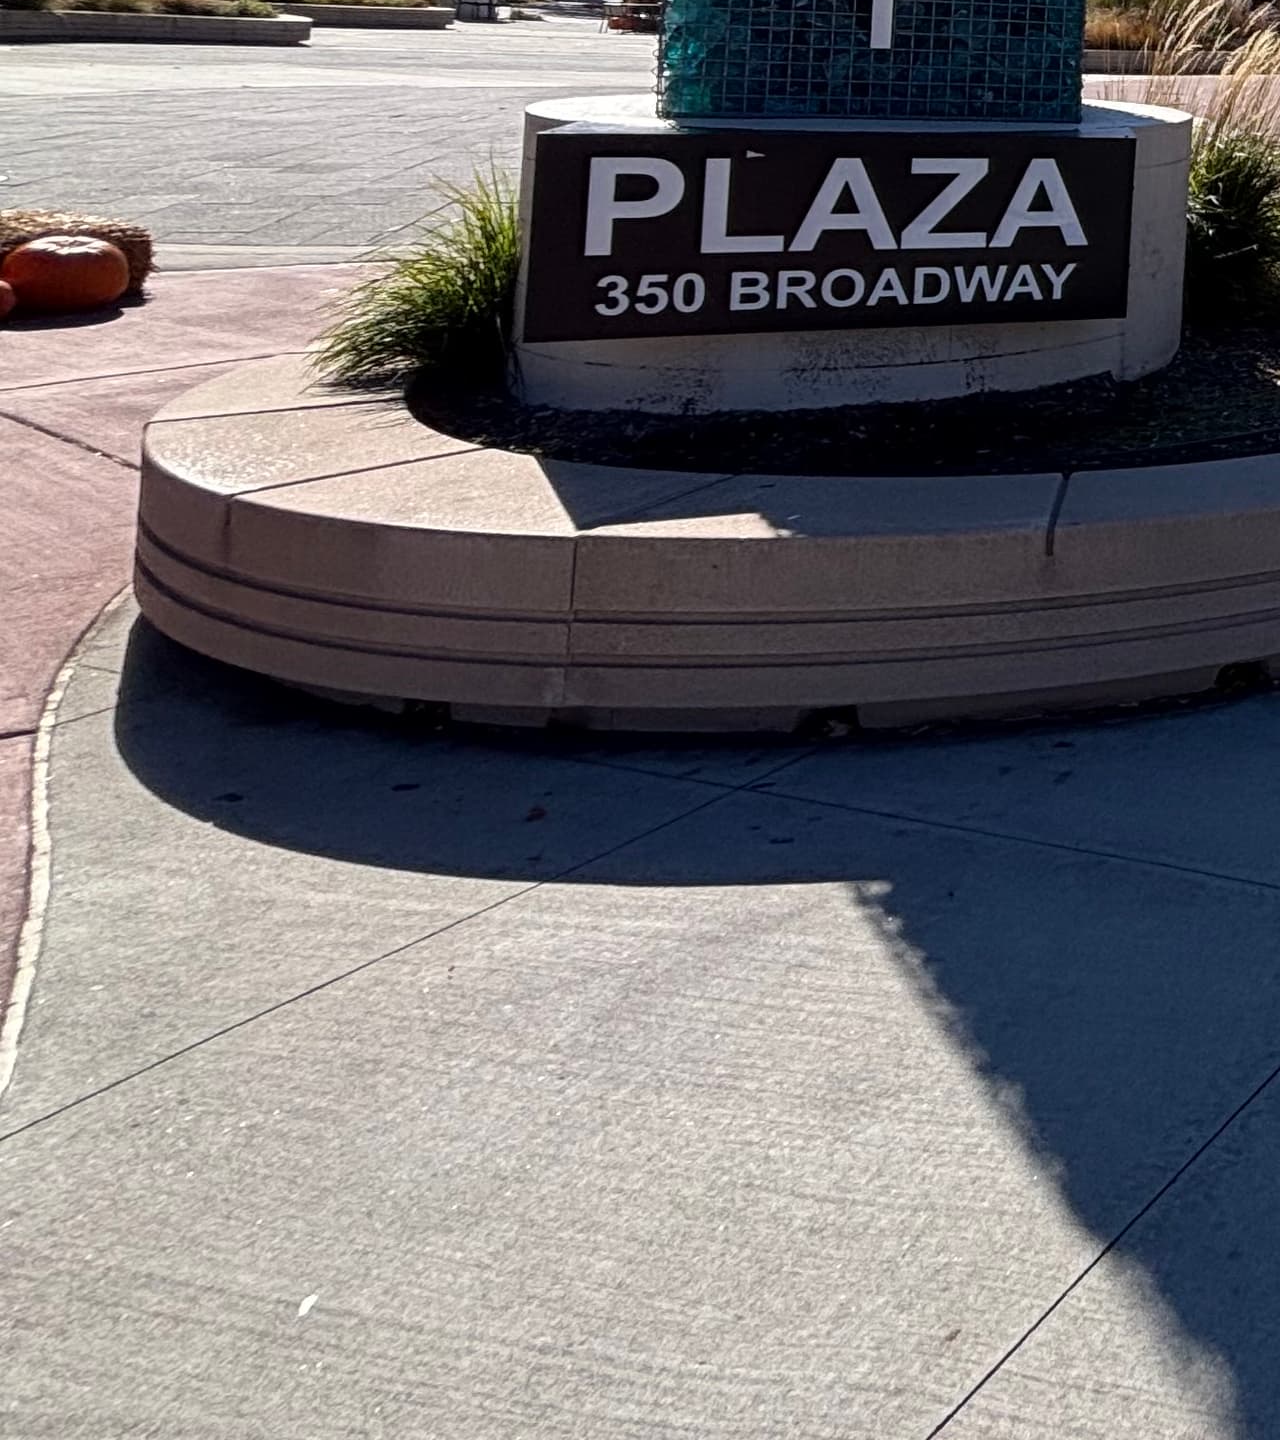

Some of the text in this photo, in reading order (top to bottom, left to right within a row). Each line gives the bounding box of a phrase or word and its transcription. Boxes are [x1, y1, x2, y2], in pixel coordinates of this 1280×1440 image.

[584, 157, 1089, 257] PLAZA
[594, 263, 1078, 316] 350 BROADWAY
